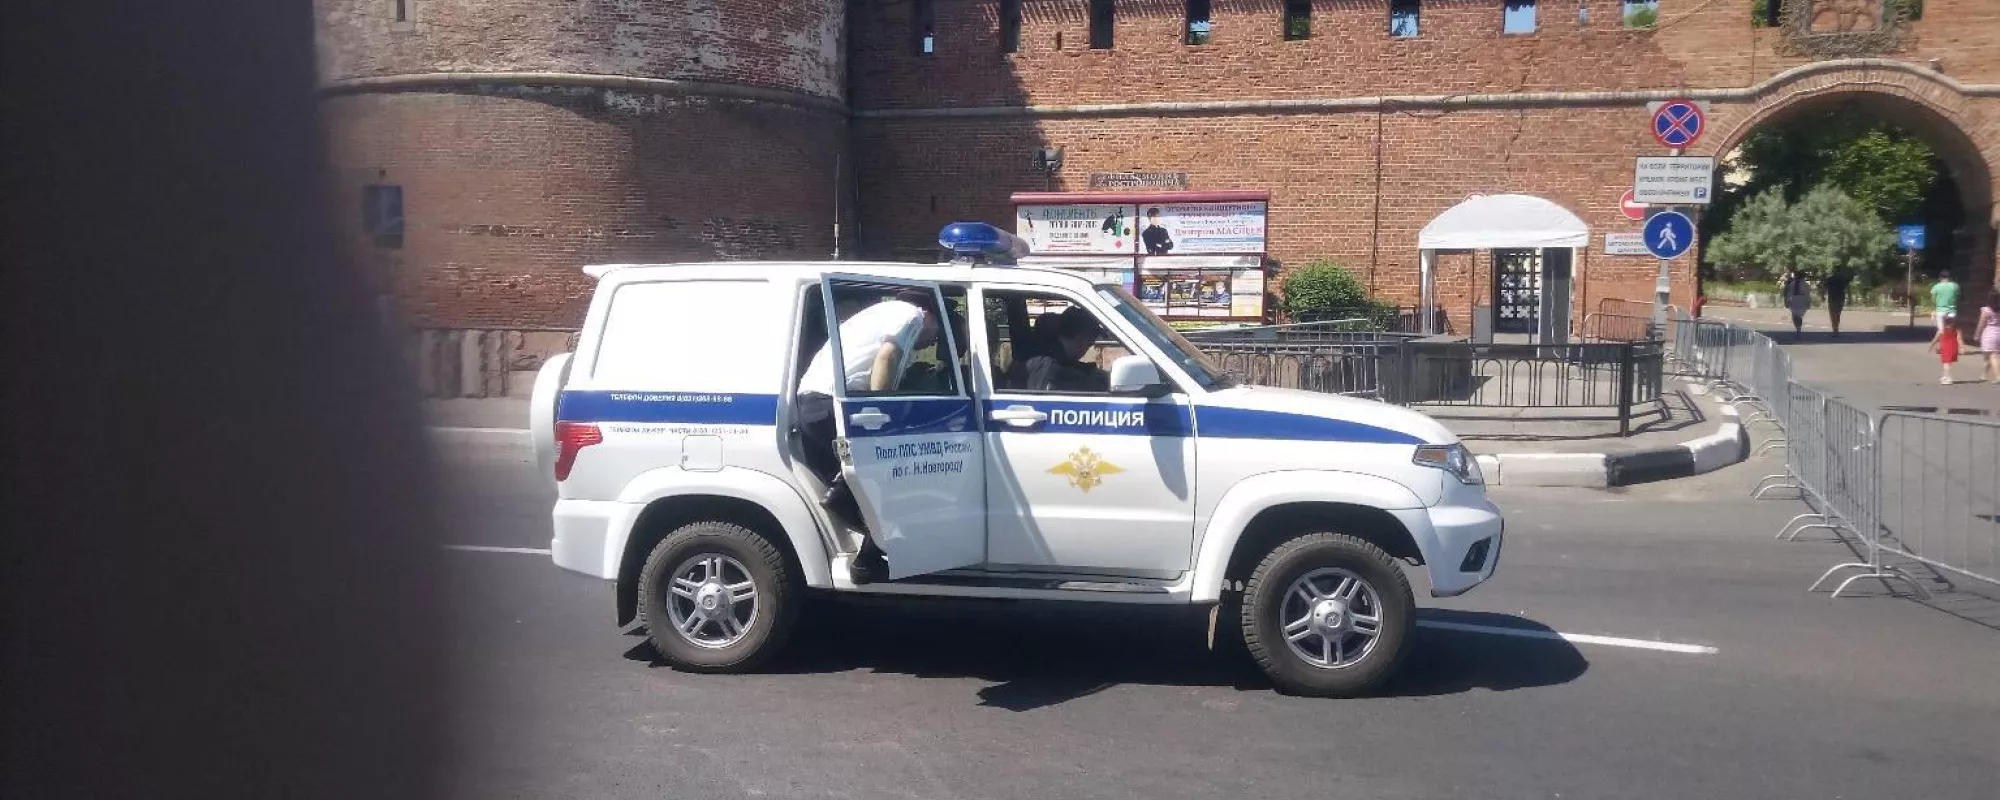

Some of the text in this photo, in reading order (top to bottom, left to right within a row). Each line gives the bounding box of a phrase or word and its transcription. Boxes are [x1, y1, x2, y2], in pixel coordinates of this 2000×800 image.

[1051, 409, 1144, 428] ПОЛИЦИЯ
[875, 446, 897, 460] Полк
[898, 443, 917, 459] ППС
[918, 441, 943, 458] УМВД
[892, 467, 903, 479] по
[904, 466, 911, 476] г.
